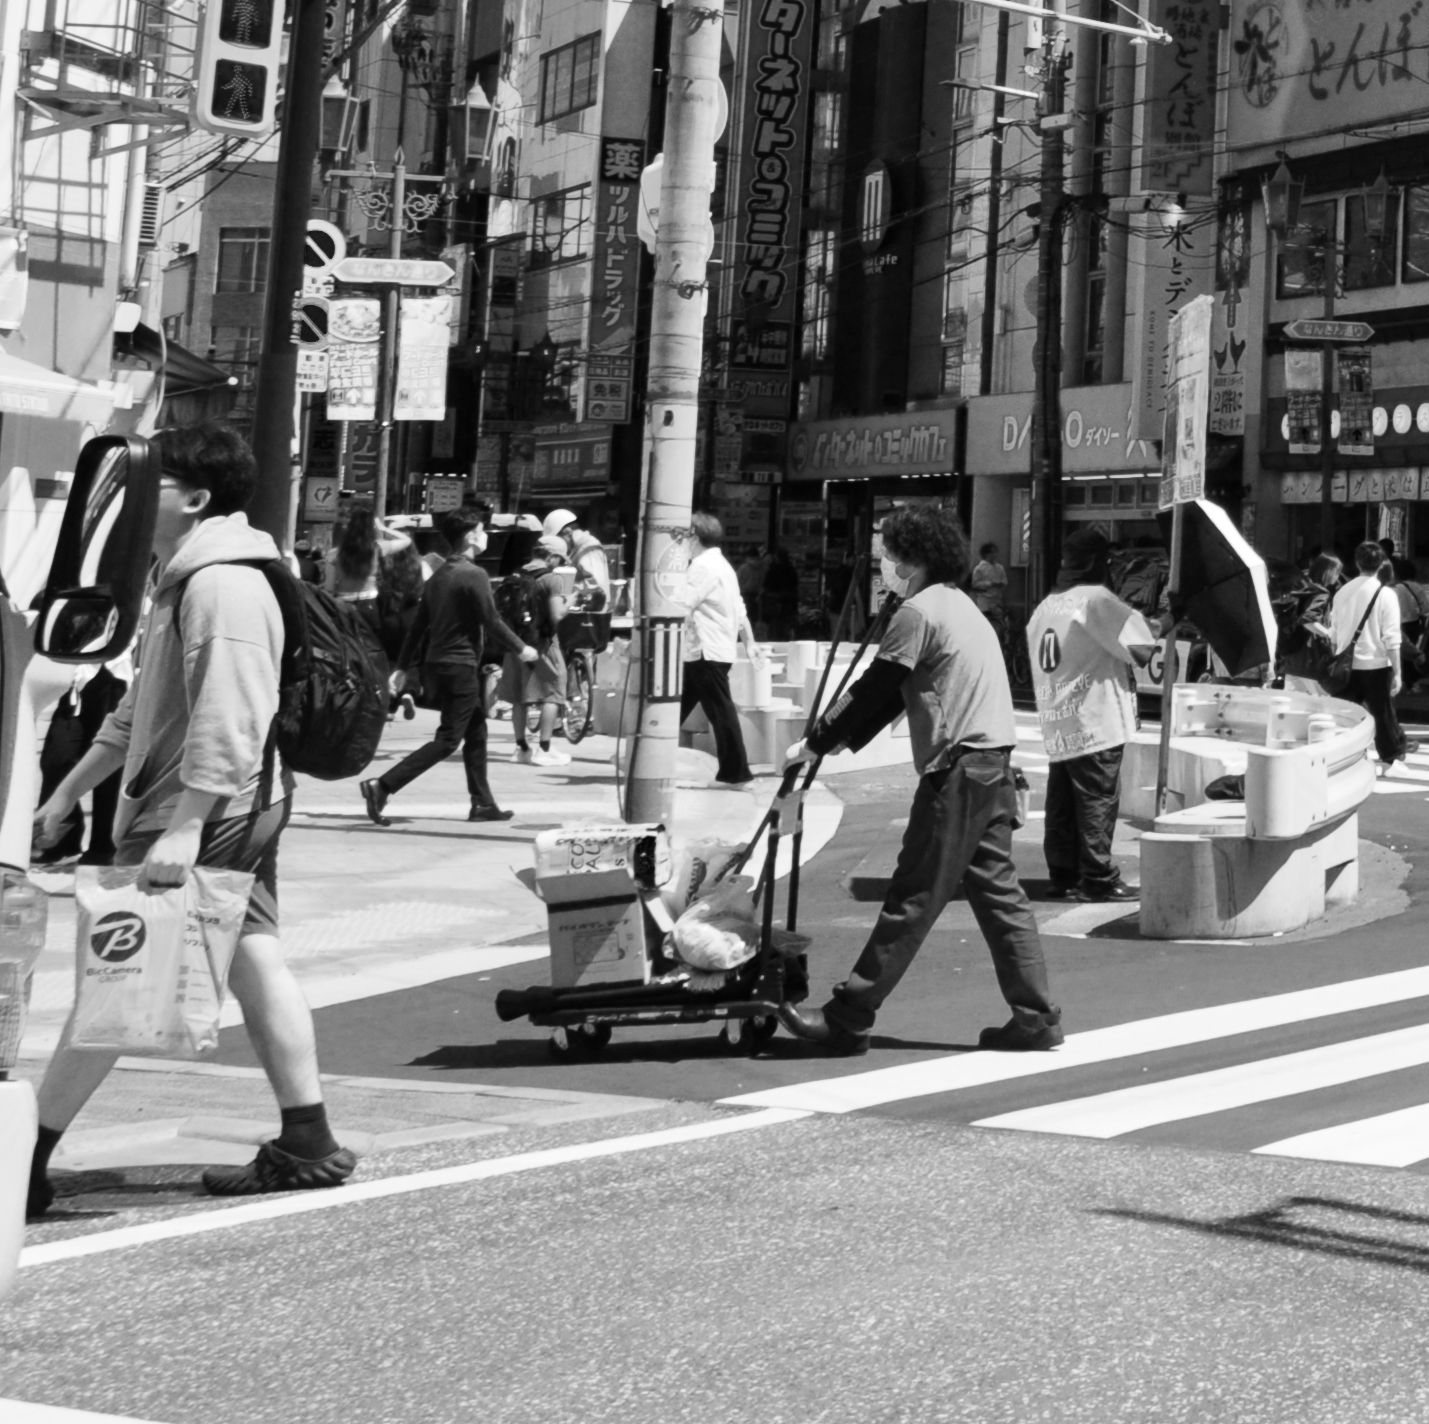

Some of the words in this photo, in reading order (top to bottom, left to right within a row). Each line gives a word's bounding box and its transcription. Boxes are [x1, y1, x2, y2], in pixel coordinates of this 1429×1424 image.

[604, 141, 641, 180] 薬
[600, 185, 629, 328] ツルハドラッグ
[1085, 427, 1120, 445] ダイソー
